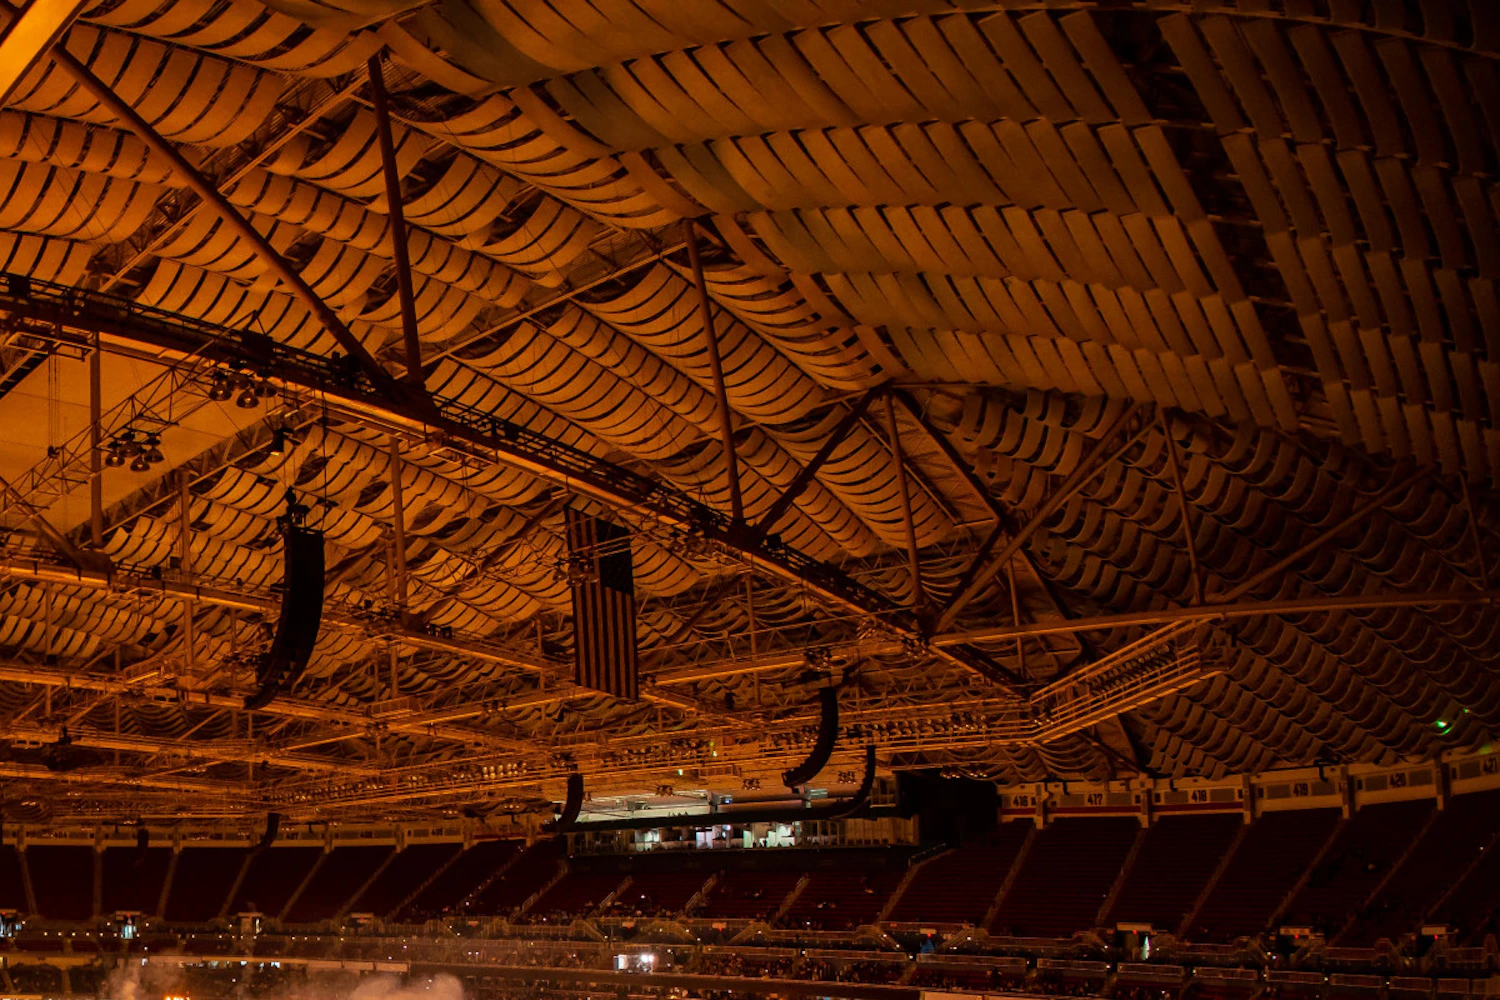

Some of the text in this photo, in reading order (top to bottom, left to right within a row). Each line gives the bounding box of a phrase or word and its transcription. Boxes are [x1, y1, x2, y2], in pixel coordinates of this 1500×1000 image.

[1390, 774, 1406, 787] 420
[1293, 783, 1308, 796] 419
[1087, 794, 1103, 806] 417
[1191, 790, 1207, 802] 418
